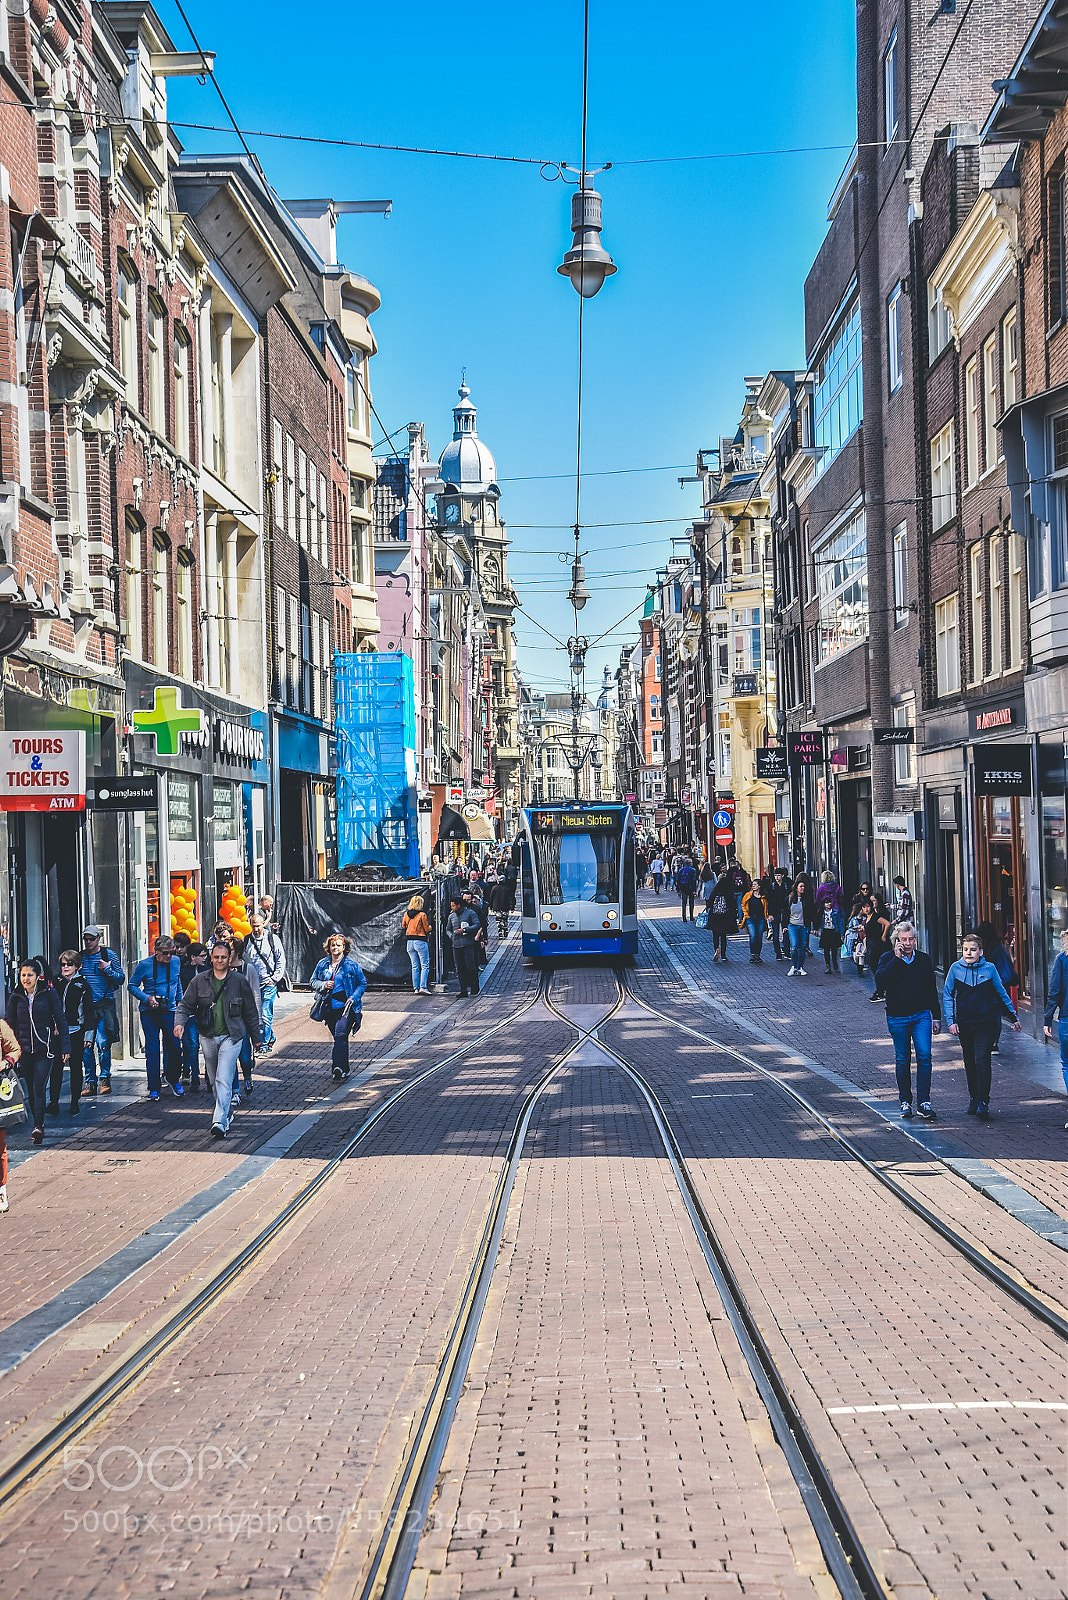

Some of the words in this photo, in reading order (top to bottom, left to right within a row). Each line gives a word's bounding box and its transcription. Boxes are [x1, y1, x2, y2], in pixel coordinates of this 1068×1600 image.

[801, 734, 814, 742] ICI
[12, 738, 64, 755] TOURS
[794, 744, 821, 753] PARIS
[30, 755, 43, 770] &
[802, 755, 813, 763] XL
[6, 770, 70, 787] TICKETS
[983, 771, 1022, 779] IKKS
[110, 790, 140, 799] sunglass
[141, 788, 154, 797] hut
[49, 797, 75, 808] ATM
[561, 815, 585, 827] Nieuw
[587, 814, 613, 826] Sloten
